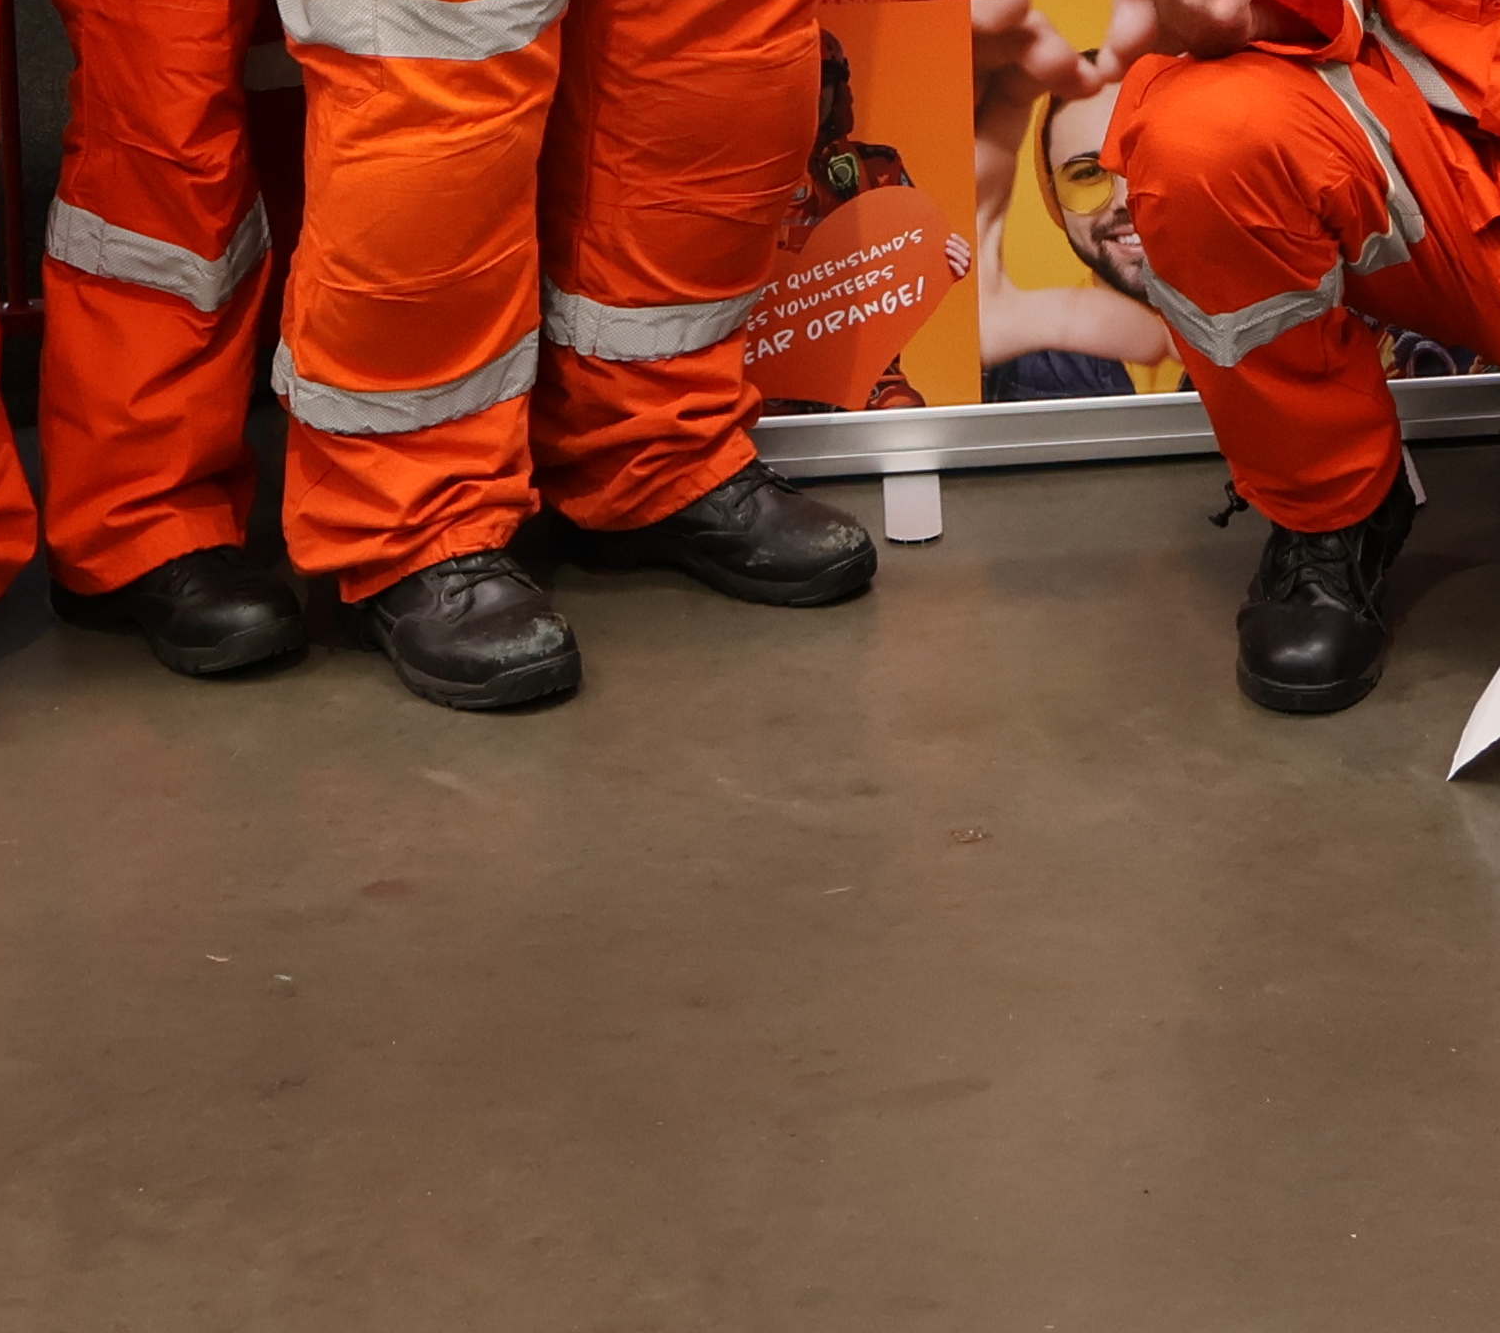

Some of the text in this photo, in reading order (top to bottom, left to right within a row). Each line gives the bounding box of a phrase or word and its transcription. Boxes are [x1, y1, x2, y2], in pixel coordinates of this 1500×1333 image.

[787, 228, 924, 291] QUEENSLAND'S
[744, 275, 926, 365] EAR ORANGE!
[746, 311, 768, 331] ES
[774, 264, 895, 319] VOLUNTEERS
